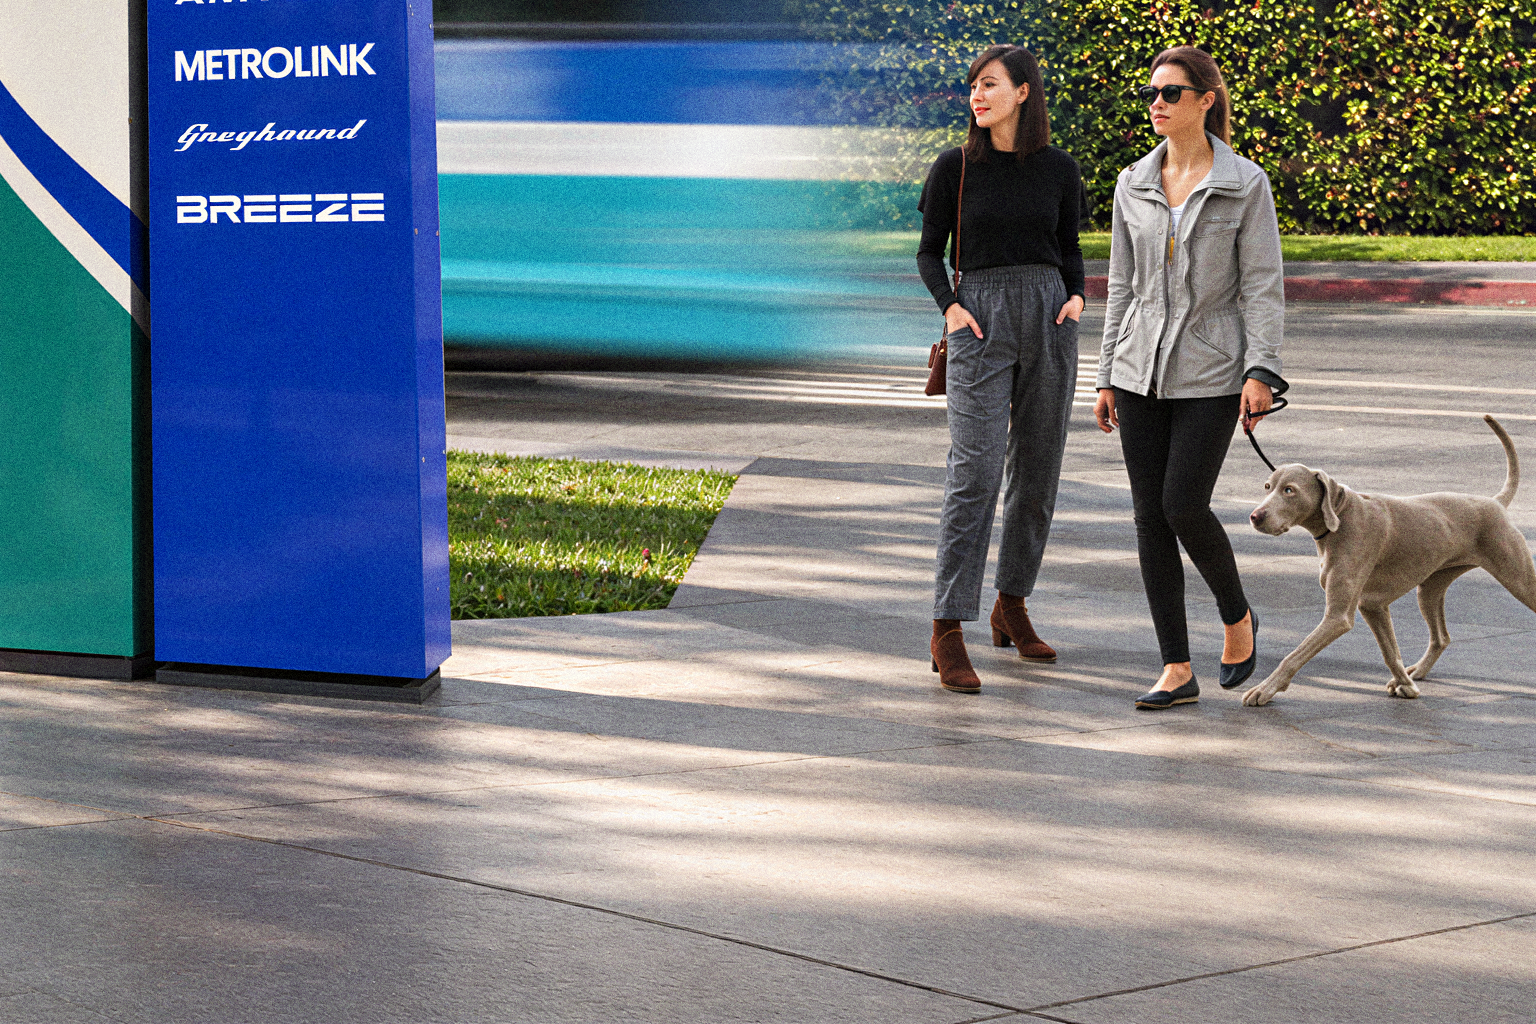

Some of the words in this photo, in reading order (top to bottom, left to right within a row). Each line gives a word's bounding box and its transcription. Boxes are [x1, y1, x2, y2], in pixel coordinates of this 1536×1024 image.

[175, 42, 376, 82] METROLINK
[174, 119, 367, 152] Greyhound
[176, 192, 385, 224] BREEZE
